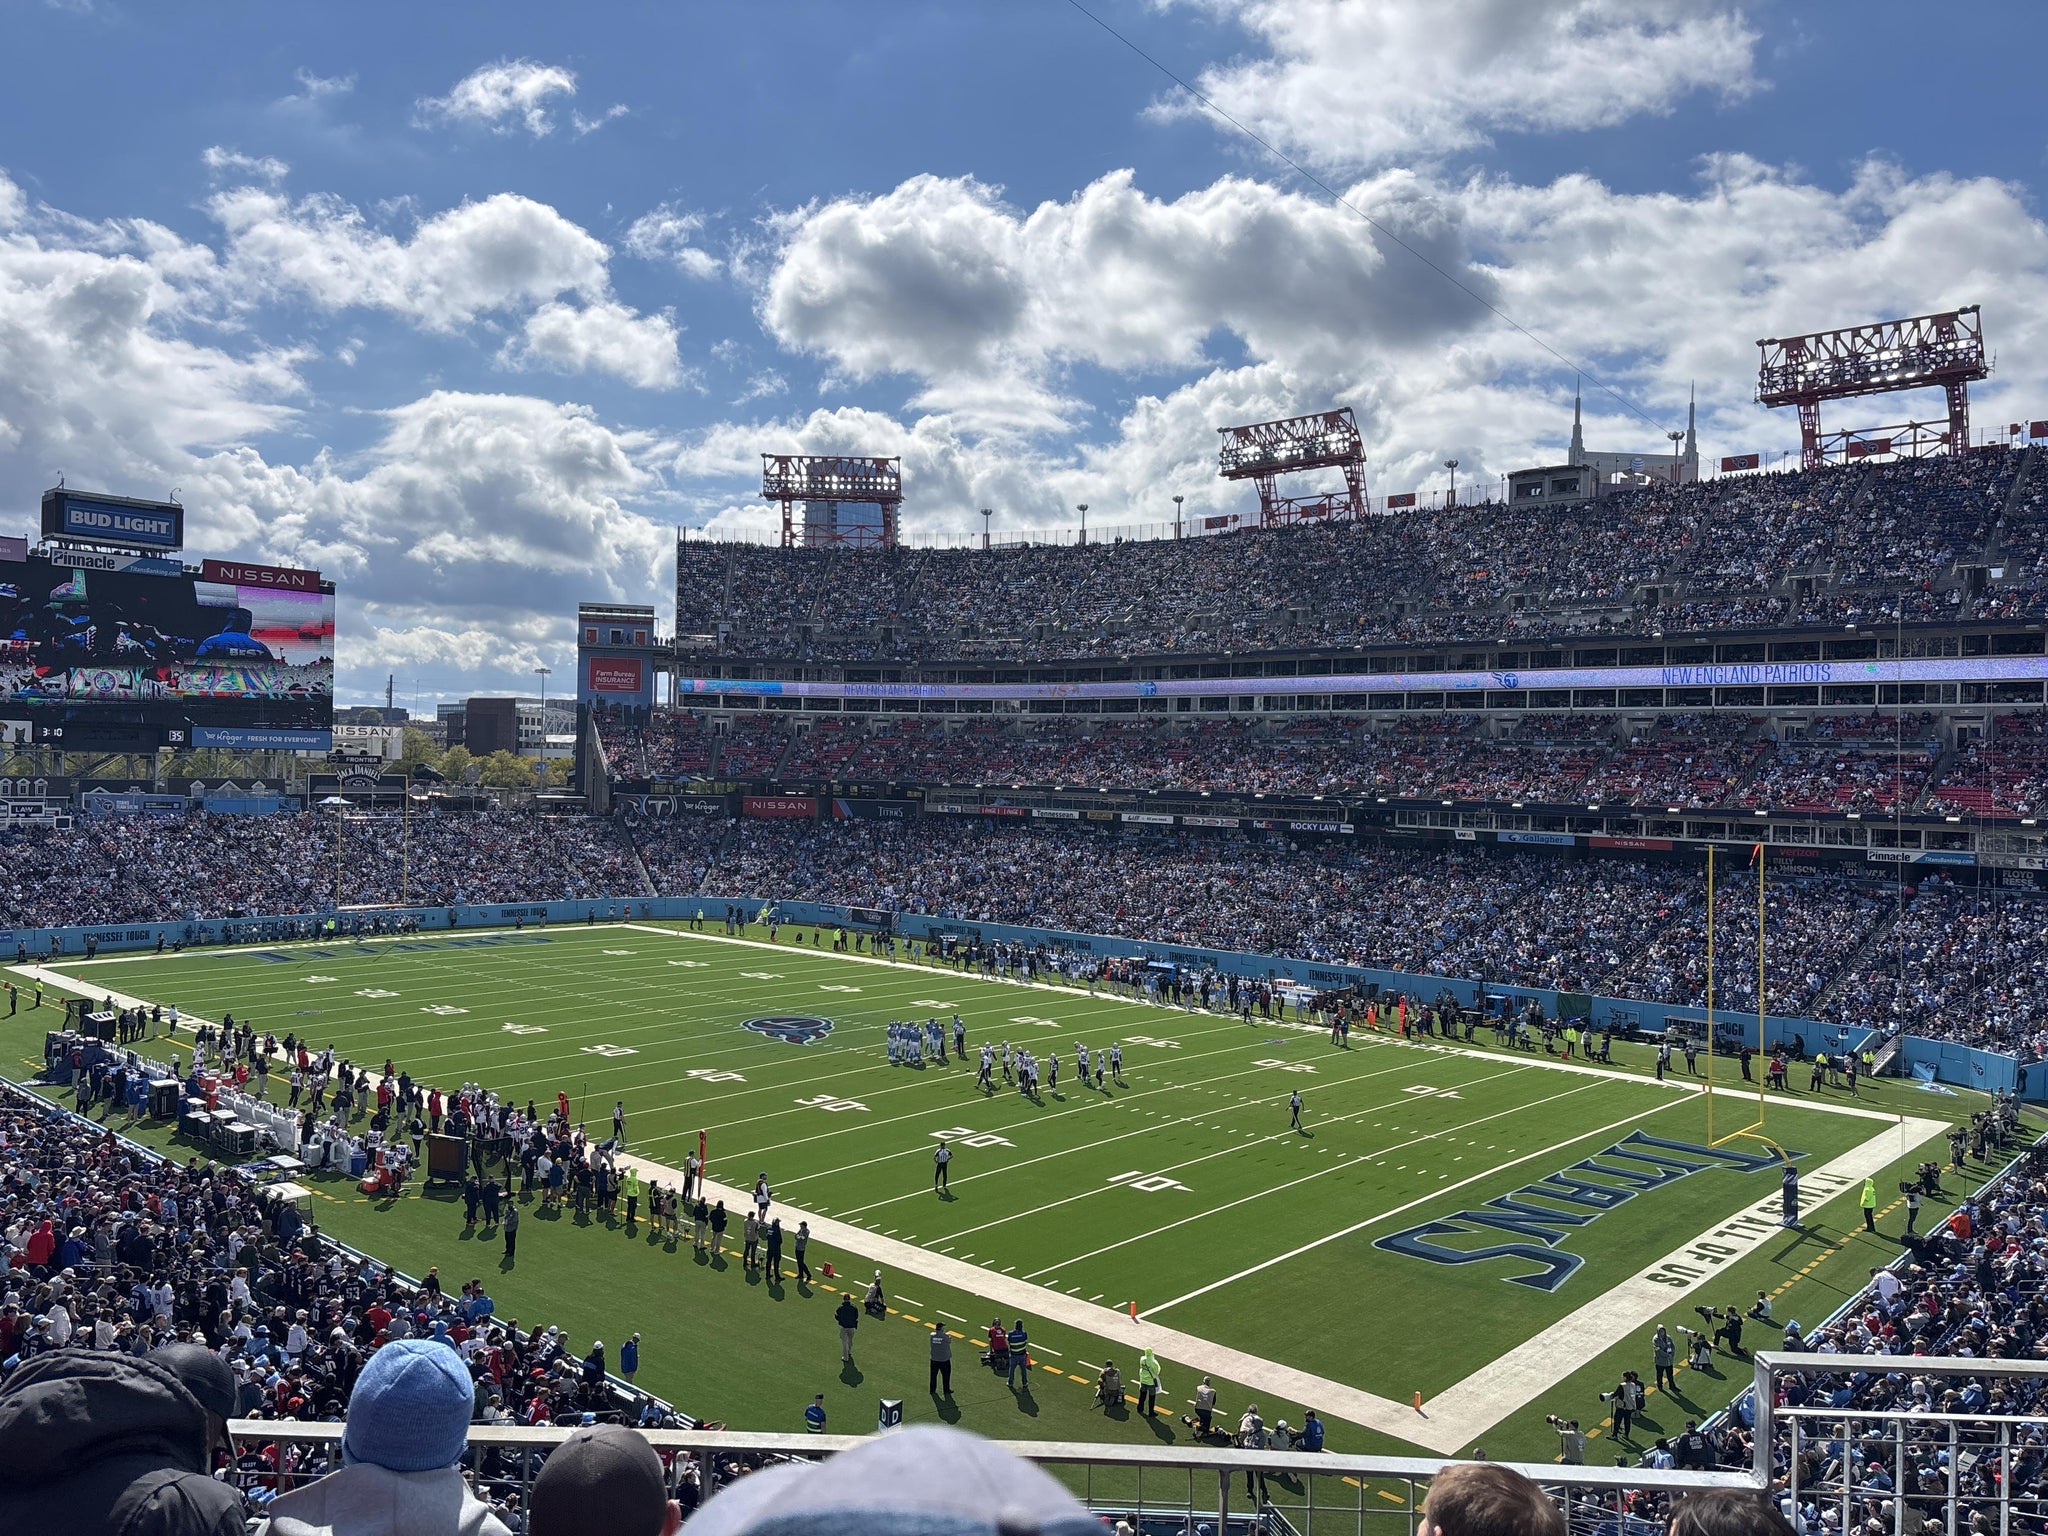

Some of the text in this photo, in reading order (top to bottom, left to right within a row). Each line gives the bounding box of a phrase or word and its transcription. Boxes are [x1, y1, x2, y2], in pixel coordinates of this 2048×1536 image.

[70, 510, 170, 534] BUD LIGHT
[53, 550, 116, 570] Pinnacle
[130, 565, 181, 577] TitansBanking.com
[220, 567, 305, 586] NISSAN
[613, 670, 636, 678] Bureau
[1662, 663, 1832, 684] NEW ENGLAND PATRIOTS
[171, 731, 182, 741] 35
[216, 730, 243, 745] Kroger
[247, 735, 267, 743] FRESH
[269, 735, 283, 743] FOR
[331, 726, 392, 737] NISSAN
[336, 766, 355, 781] JACK
[694, 800, 720, 814] Kroger
[752, 801, 807, 810] NISSAN
[878, 806, 904, 818] TITANS
[1253, 820, 1273, 829] FedEx
[1290, 822, 1338, 832] ROCKY LAW
[1523, 833, 1564, 844] Gallagher
[1781, 848, 1820, 857] verizon
[1869, 851, 1911, 862] Pinnacle
[2002, 869, 2034, 879] FLOYD
[2002, 877, 2034, 888] REESE
[126, 930, 150, 941] TOUGH
[1308, 969, 1343, 983] TENNESSEE
[1121, 1035, 1182, 1049] 30
[579, 1043, 640, 1057] 50
[1250, 1058, 1319, 1074] 20
[685, 1068, 745, 1083] 40
[794, 1094, 863, 1112] 30
[367, 1136, 378, 1144] 52
[929, 1126, 1009, 1148] 20
[1106, 1170, 1184, 1193] 10
[1371, 1129, 1811, 1293] TITANS
[1712, 1215, 1777, 1242] ALL
[1685, 1241, 1738, 1265] OF
[1644, 1263, 1706, 1288] US
[346, 1287, 360, 1299] 53
[238, 1469, 259, 1487] 12
